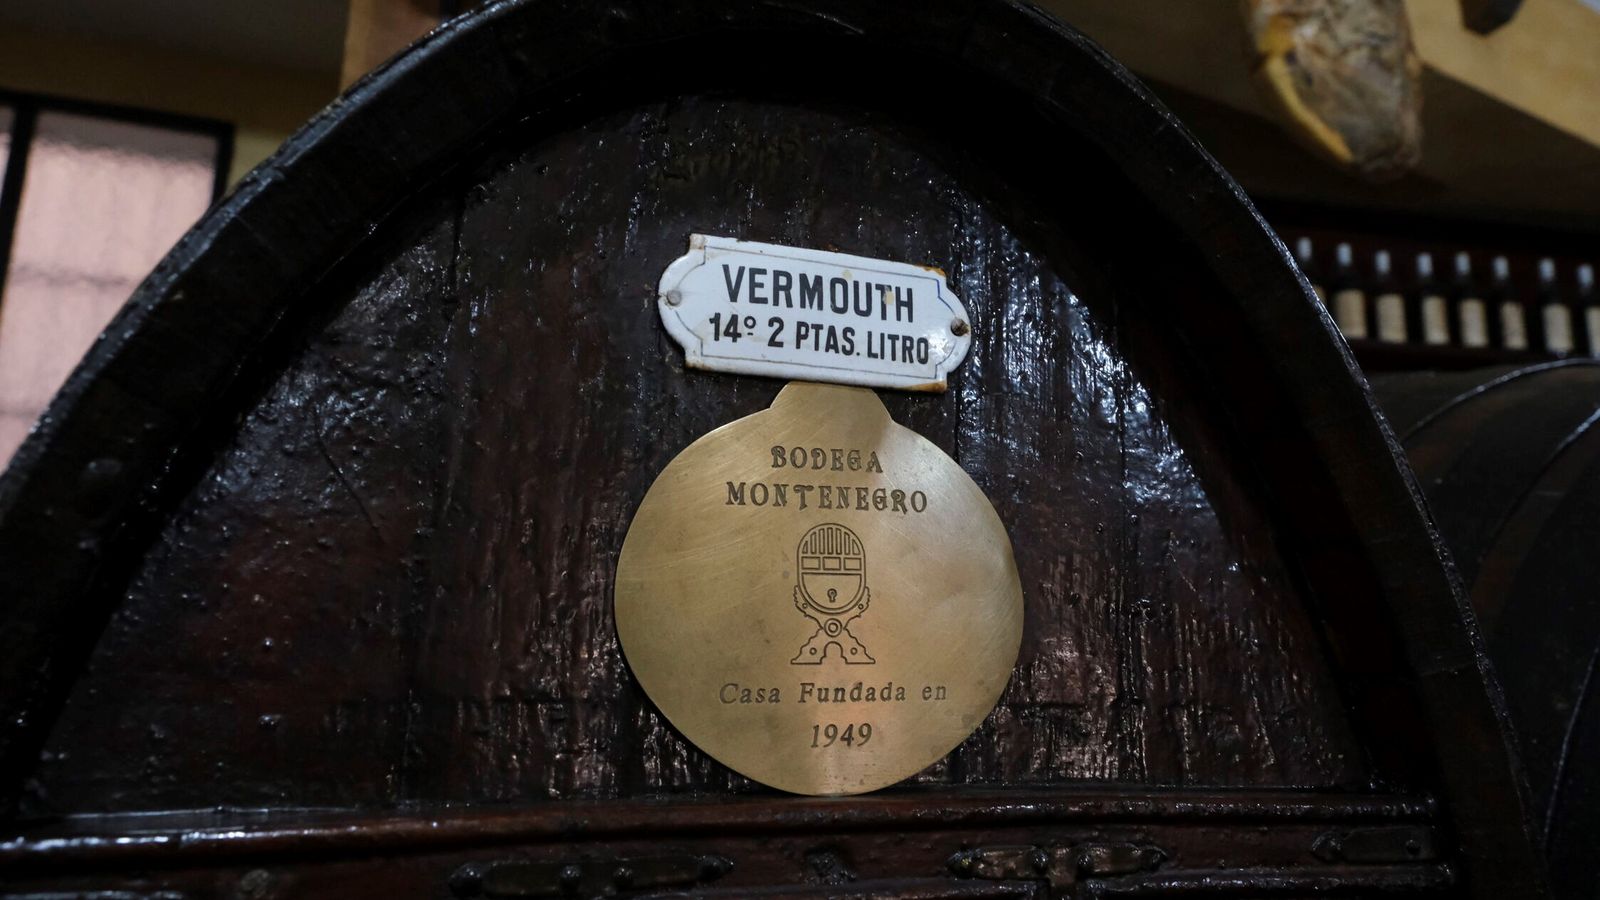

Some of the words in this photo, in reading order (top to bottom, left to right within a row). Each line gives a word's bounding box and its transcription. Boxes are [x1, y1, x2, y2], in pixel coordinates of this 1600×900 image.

[723, 265, 914, 323] VERMOUTH
[768, 317, 784, 347] 2
[795, 321, 860, 356] PTAS.
[867, 331, 929, 365] LITRO
[771, 445, 883, 473] BODEGA
[725, 481, 928, 514] MONTENEGRO
[719, 682, 781, 704] Casa
[798, 681, 906, 704] Fundada
[922, 685, 947, 701] en
[811, 722, 873, 748] 1949
